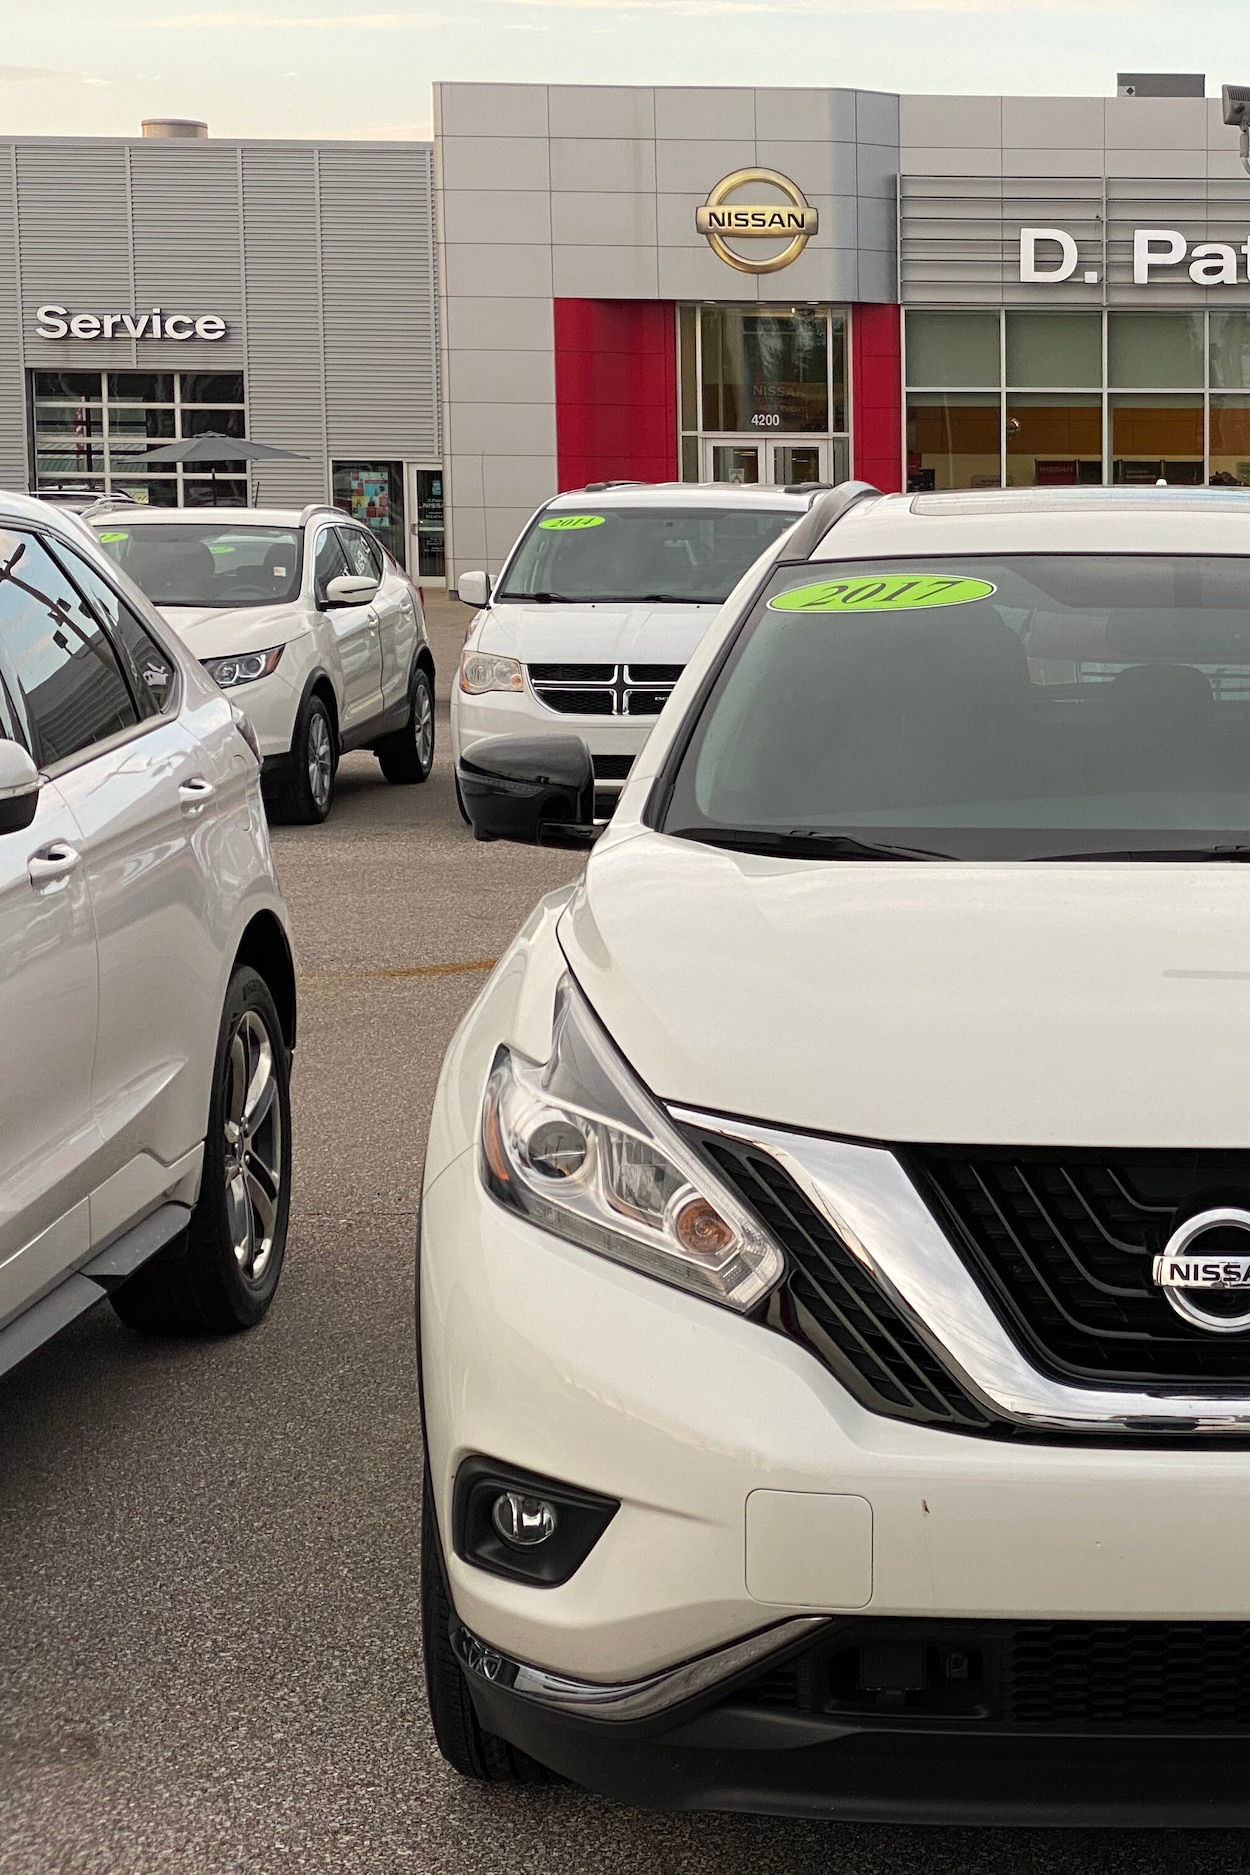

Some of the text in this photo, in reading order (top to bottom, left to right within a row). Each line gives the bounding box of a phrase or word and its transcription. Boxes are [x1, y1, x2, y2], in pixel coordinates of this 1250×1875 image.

[708, 212, 805, 228] NISSAN
[1020, 228, 1097, 283] D.
[35, 304, 227, 340] Service
[751, 413, 780, 426] 4200
[799, 580, 965, 608] 2017
